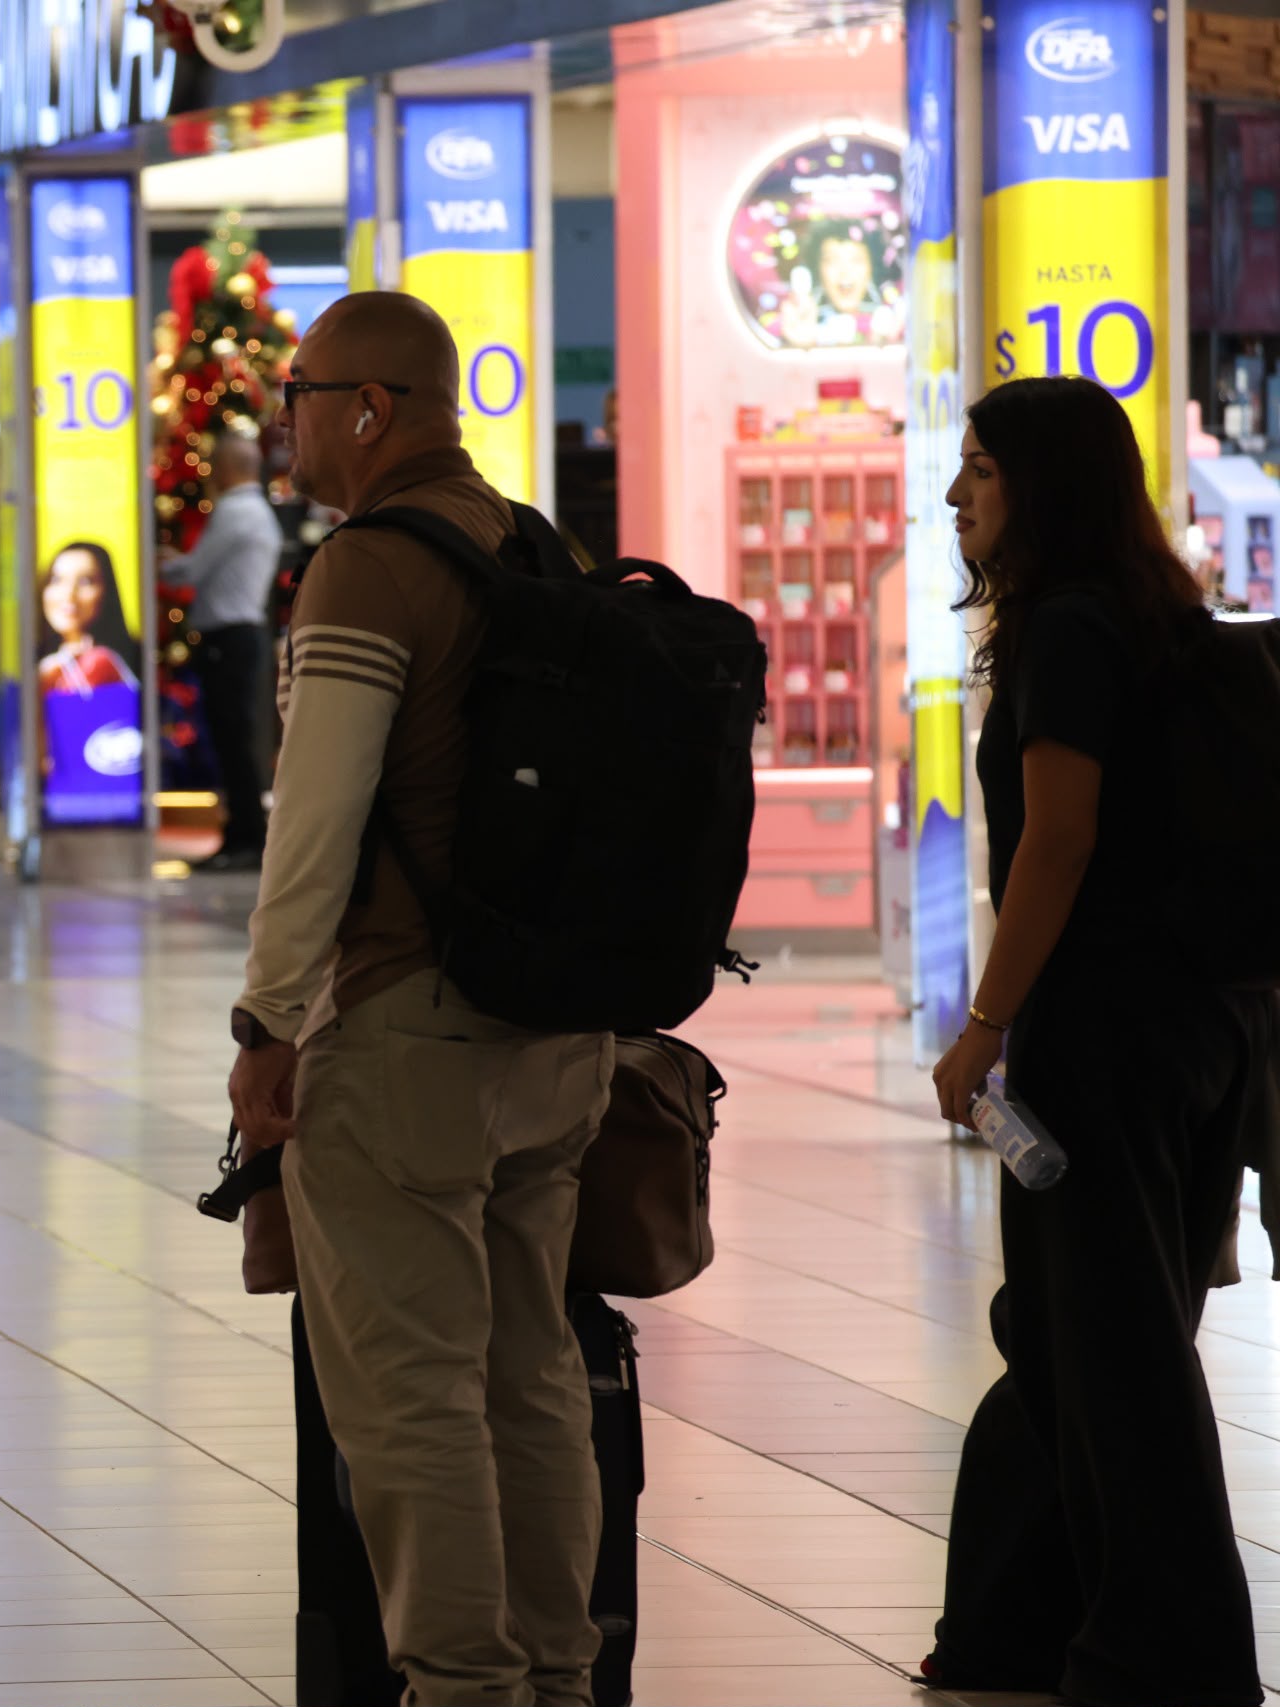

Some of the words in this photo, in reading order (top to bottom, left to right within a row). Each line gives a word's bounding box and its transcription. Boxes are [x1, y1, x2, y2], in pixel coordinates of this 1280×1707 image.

[1023, 113, 1131, 154] VISA
[426, 199, 509, 233] VISA
[1036, 264, 1113, 284] HASTA
